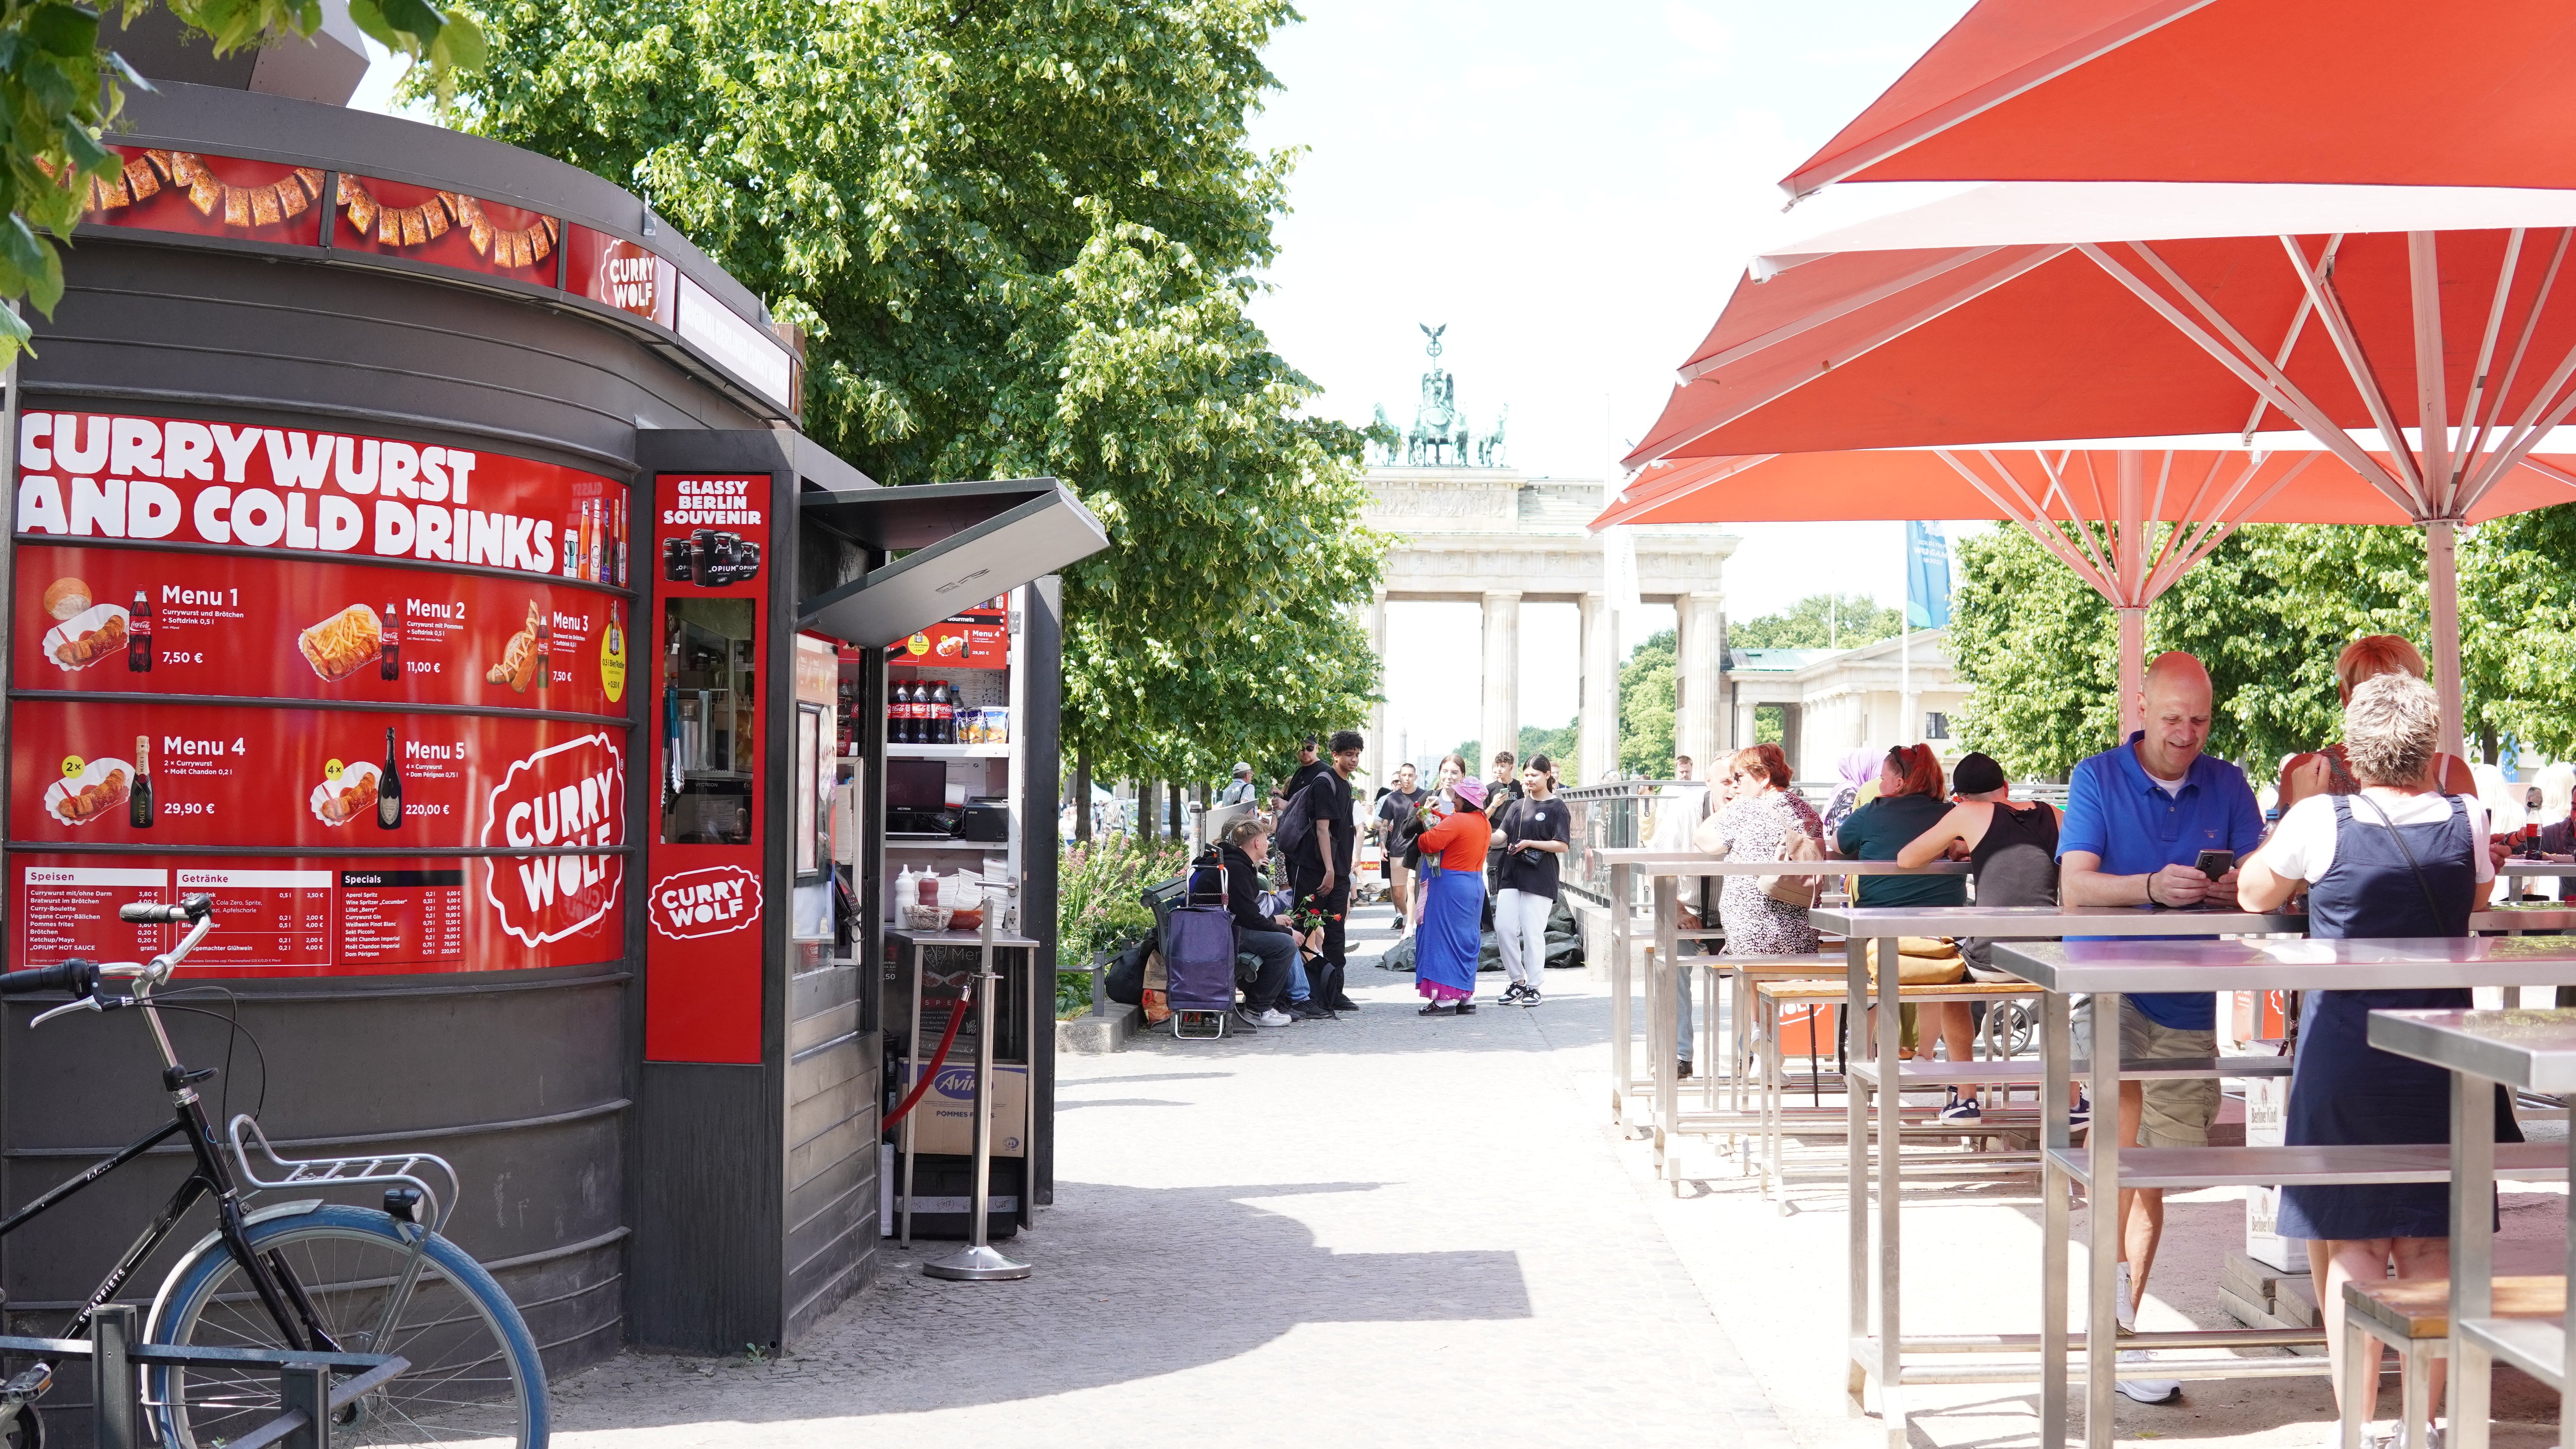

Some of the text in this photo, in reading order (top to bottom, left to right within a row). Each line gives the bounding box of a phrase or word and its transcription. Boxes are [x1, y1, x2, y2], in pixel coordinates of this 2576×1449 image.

[610, 258, 654, 283] CURRY
[613, 283, 652, 308] WOLF
[20, 412, 475, 504] CURRYWURST
[678, 481, 748, 494] GLASSY
[679, 496, 746, 509] BERLIN
[17, 475, 553, 573] AND COLD DRINKS
[664, 511, 761, 524] SOUVENIR
[163, 585, 237, 606] Menu 1
[407, 599, 465, 619] Menu 2
[554, 612, 588, 631] Menu 3
[163, 652, 203, 664] 7,50 €
[407, 662, 440, 673] 11,00 €
[553, 671, 566, 682] 7,50
[165, 736, 245, 755] Menu 4
[407, 741, 464, 759] Menu 5
[165, 803, 214, 815] 29,90 €
[406, 805, 449, 816] 220,00 €
[506, 767, 613, 860] CURRY
[31, 872, 74, 881] Speisen
[519, 823, 611, 912] WOLF
[182, 874, 228, 883] Getränke
[345, 875, 381, 884] Specials
[662, 878, 745, 908] CURRY
[669, 898, 743, 927] WOLF
[2251, 1107, 2277, 1124] Berliner Kindl
[2252, 1216, 2267, 1232] Berliner
[79, 1268, 126, 1323] SWAPFIETS
